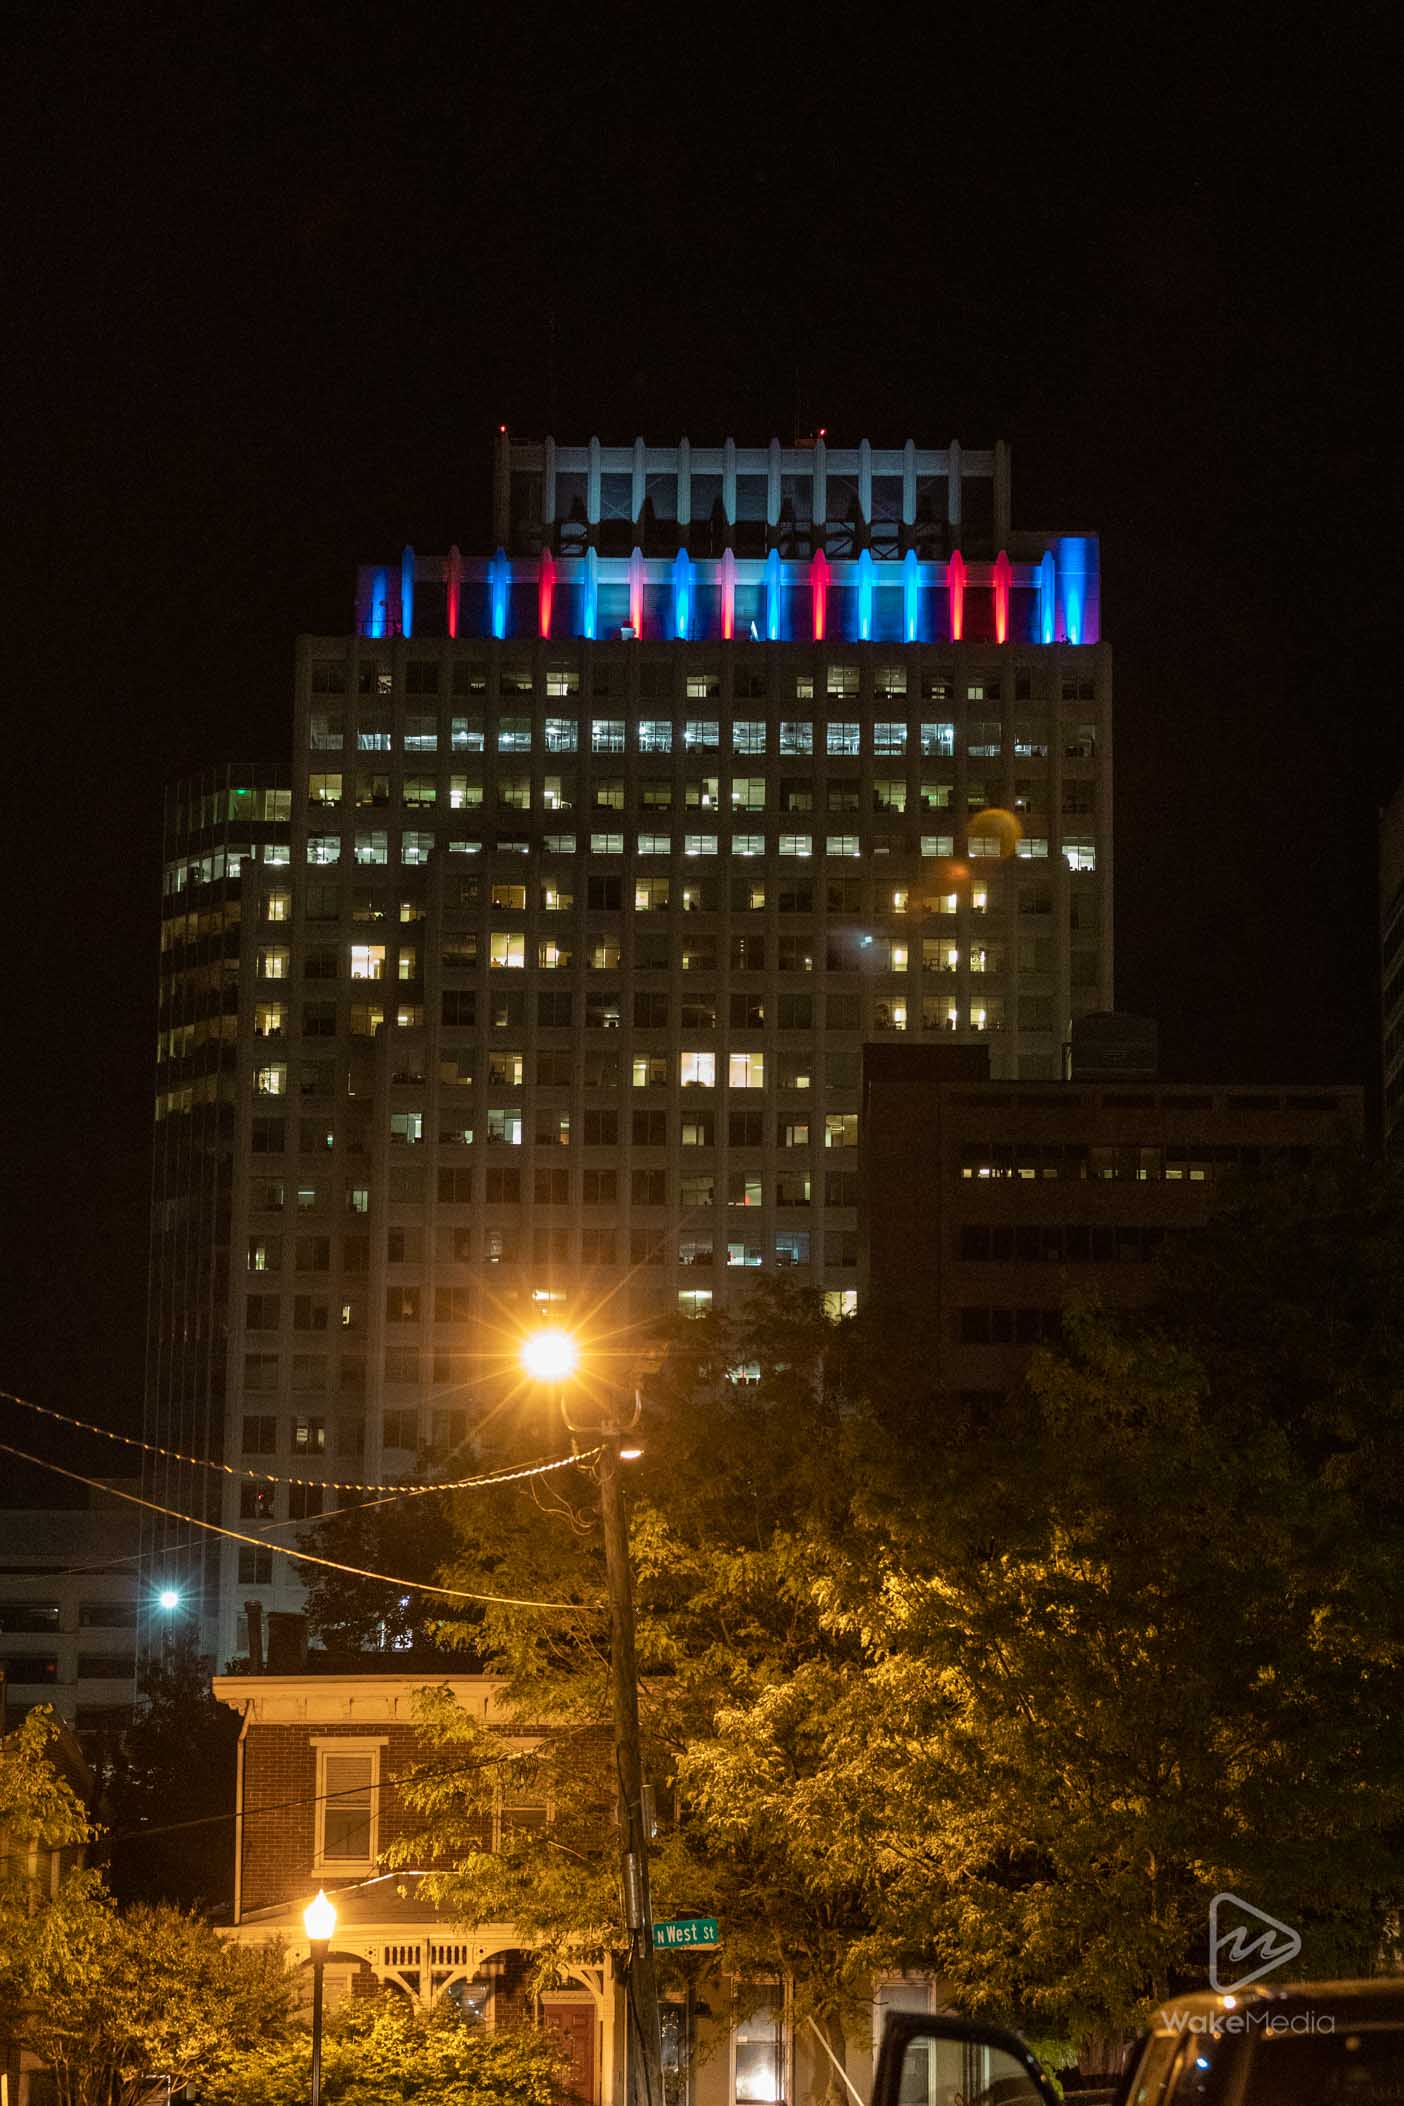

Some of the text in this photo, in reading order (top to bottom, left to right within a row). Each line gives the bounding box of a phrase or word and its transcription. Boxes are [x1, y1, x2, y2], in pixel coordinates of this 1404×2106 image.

[657, 1924, 714, 1944] N West St
